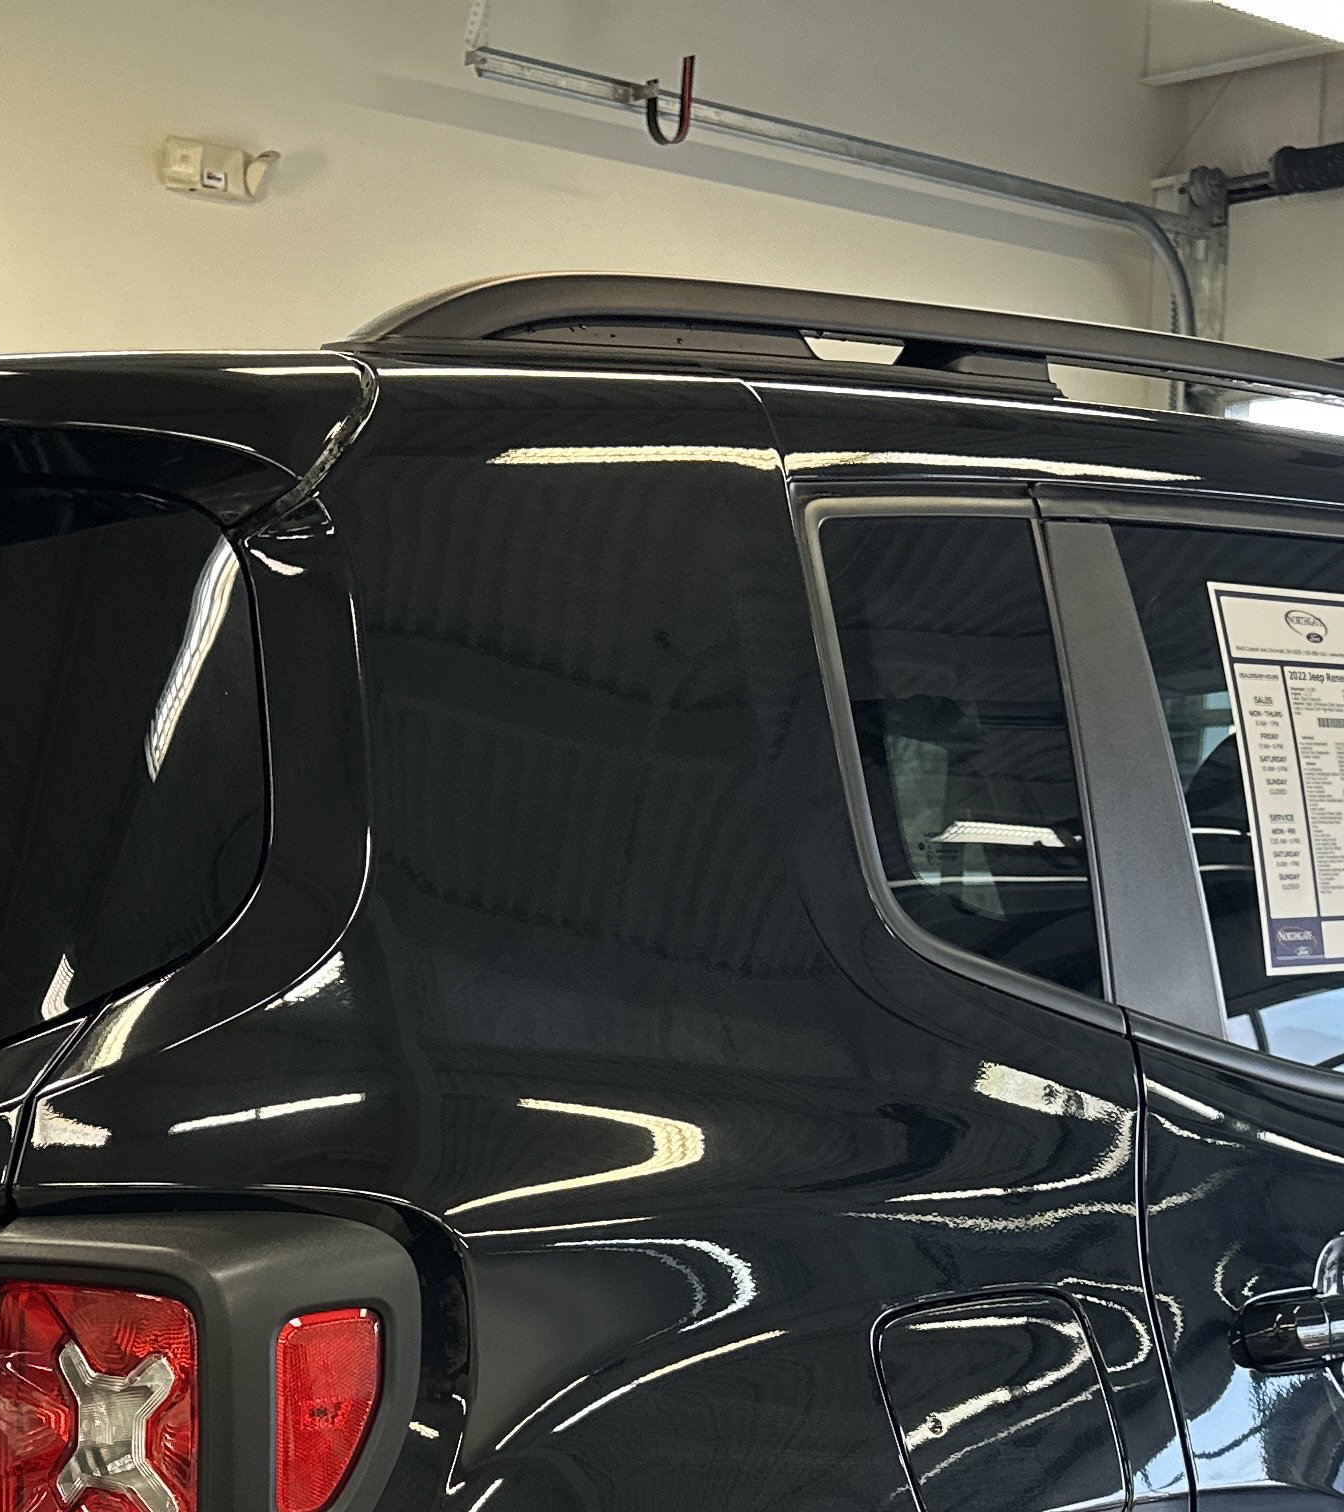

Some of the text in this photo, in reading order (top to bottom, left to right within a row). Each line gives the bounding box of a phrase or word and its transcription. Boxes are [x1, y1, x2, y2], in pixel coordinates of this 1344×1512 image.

[1288, 671, 1307, 680] 2022
[1308, 672, 1324, 683] Jeep
[1254, 696, 1273, 705] SALES
[1269, 814, 1294, 822] SERVICE
